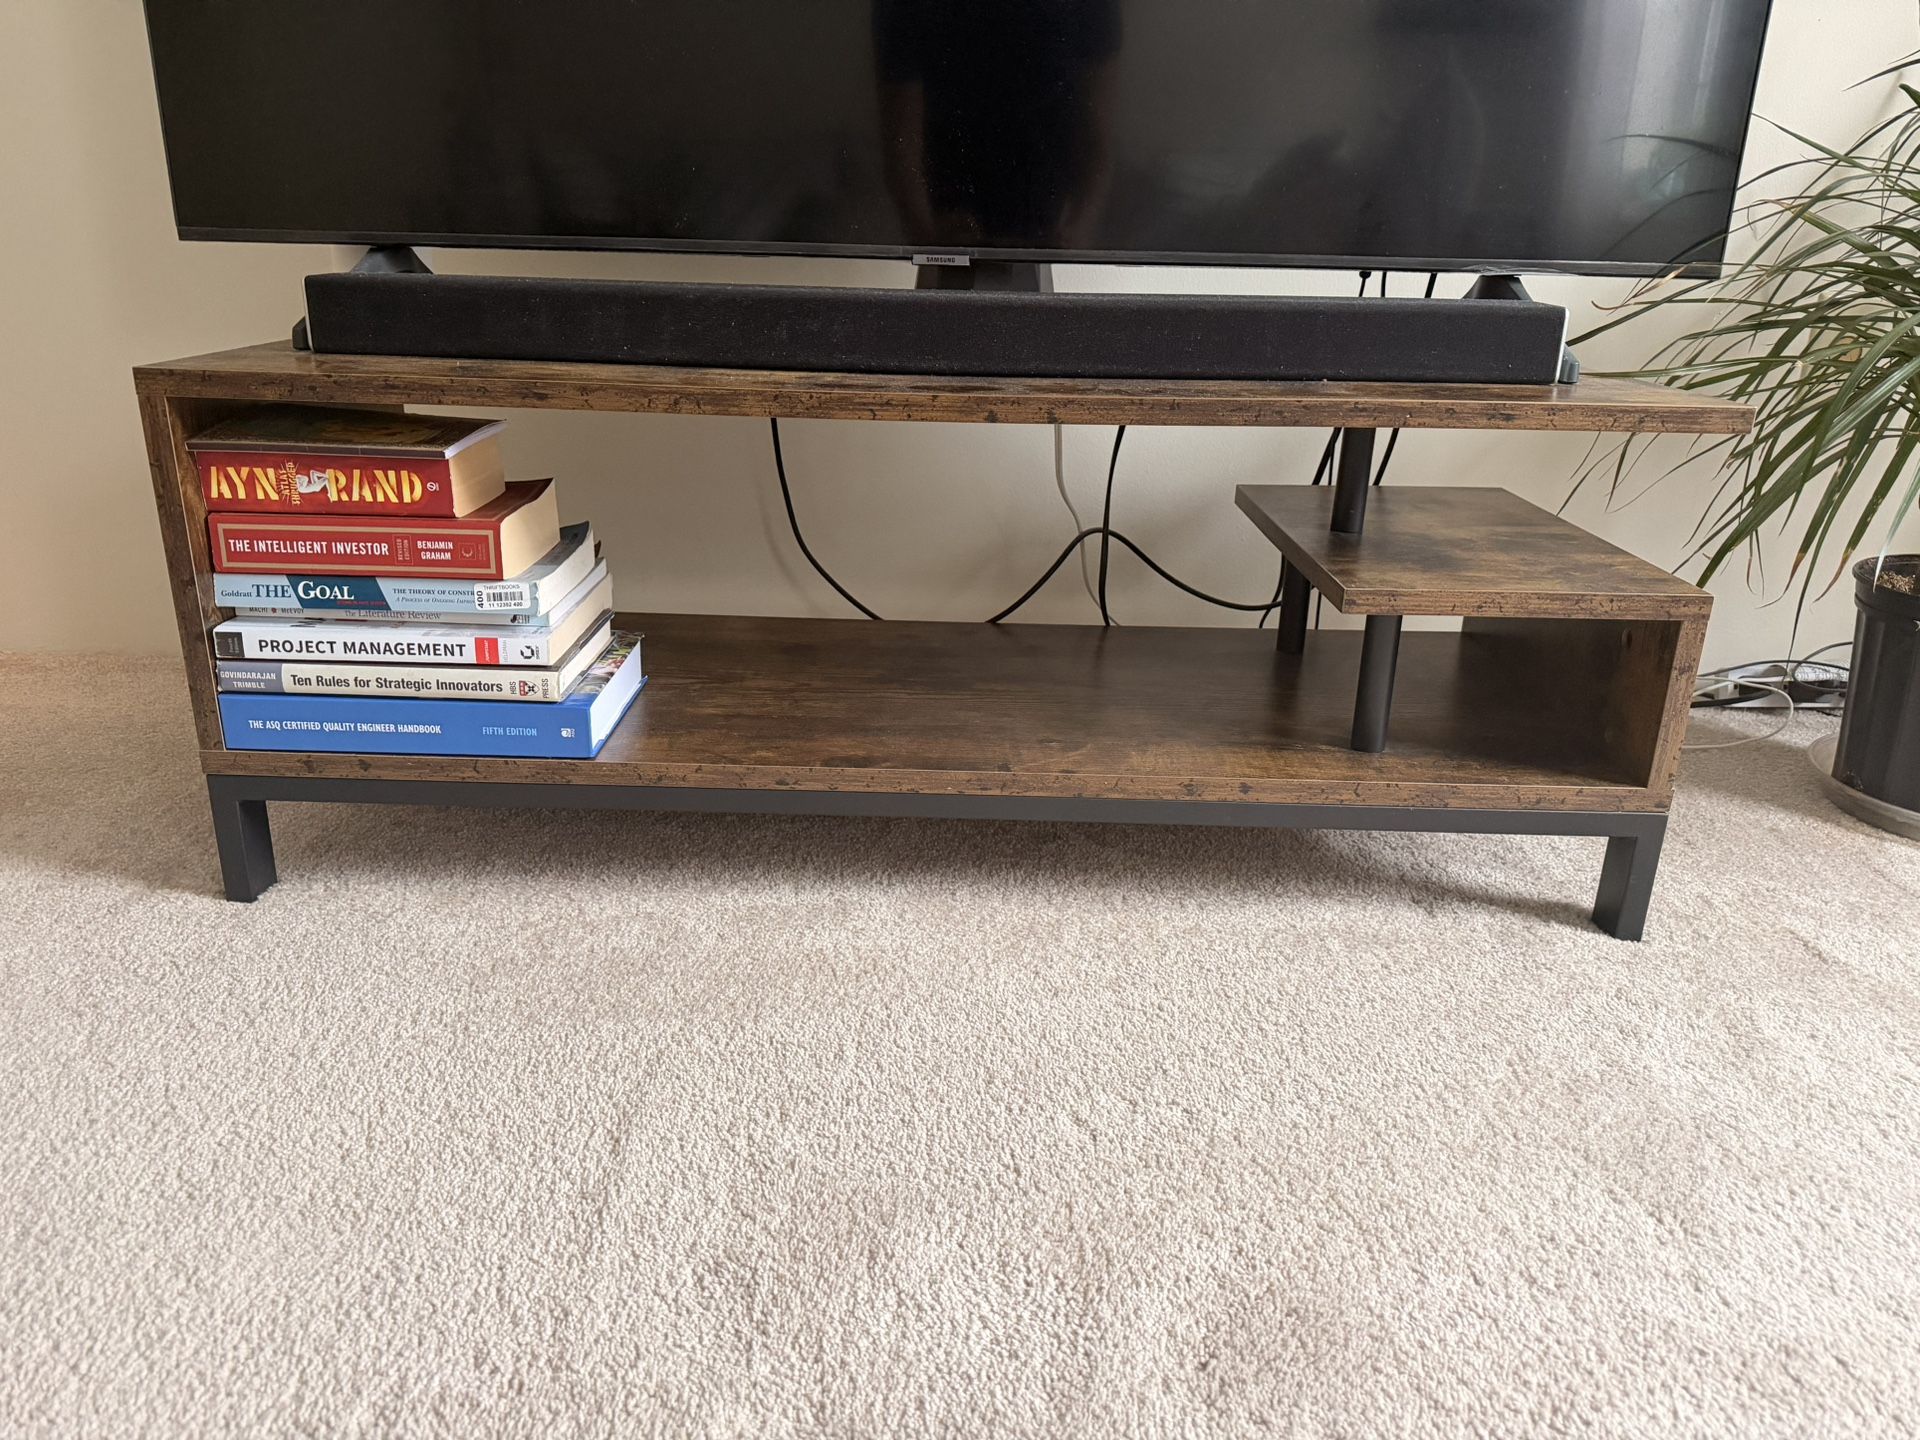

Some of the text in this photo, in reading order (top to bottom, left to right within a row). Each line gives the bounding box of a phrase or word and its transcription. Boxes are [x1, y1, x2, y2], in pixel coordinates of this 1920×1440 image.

[210, 466, 279, 501] AYN
[278, 469, 290, 496] ATLAS
[287, 462, 301, 505] SHRUGGED
[326, 468, 423, 504] RAND
[228, 539, 389, 556] THE INTELLIGENT INVESTOR
[417, 540, 454, 550] BENJAMIN
[421, 551, 451, 561] GRAHAM
[221, 589, 252, 598] Goldratt
[252, 584, 292, 598] THE
[476, 590, 484, 608] 400
[359, 609, 405, 618] Literature
[408, 611, 441, 619] Review
[258, 639, 466, 657] PROJECT MANAGEMENT
[220, 671, 276, 680] GOVINDARAJAN
[232, 681, 266, 689] TRIMBLE
[291, 674, 503, 692] Ten Rules for Strategic Innovators
[509, 681, 517, 695] HBS
[248, 720, 442, 734] THE ASQ CERTIFIED QUALITY ENGINEER HANDBOOK
[482, 726, 537, 736] FIFTH EDITION
